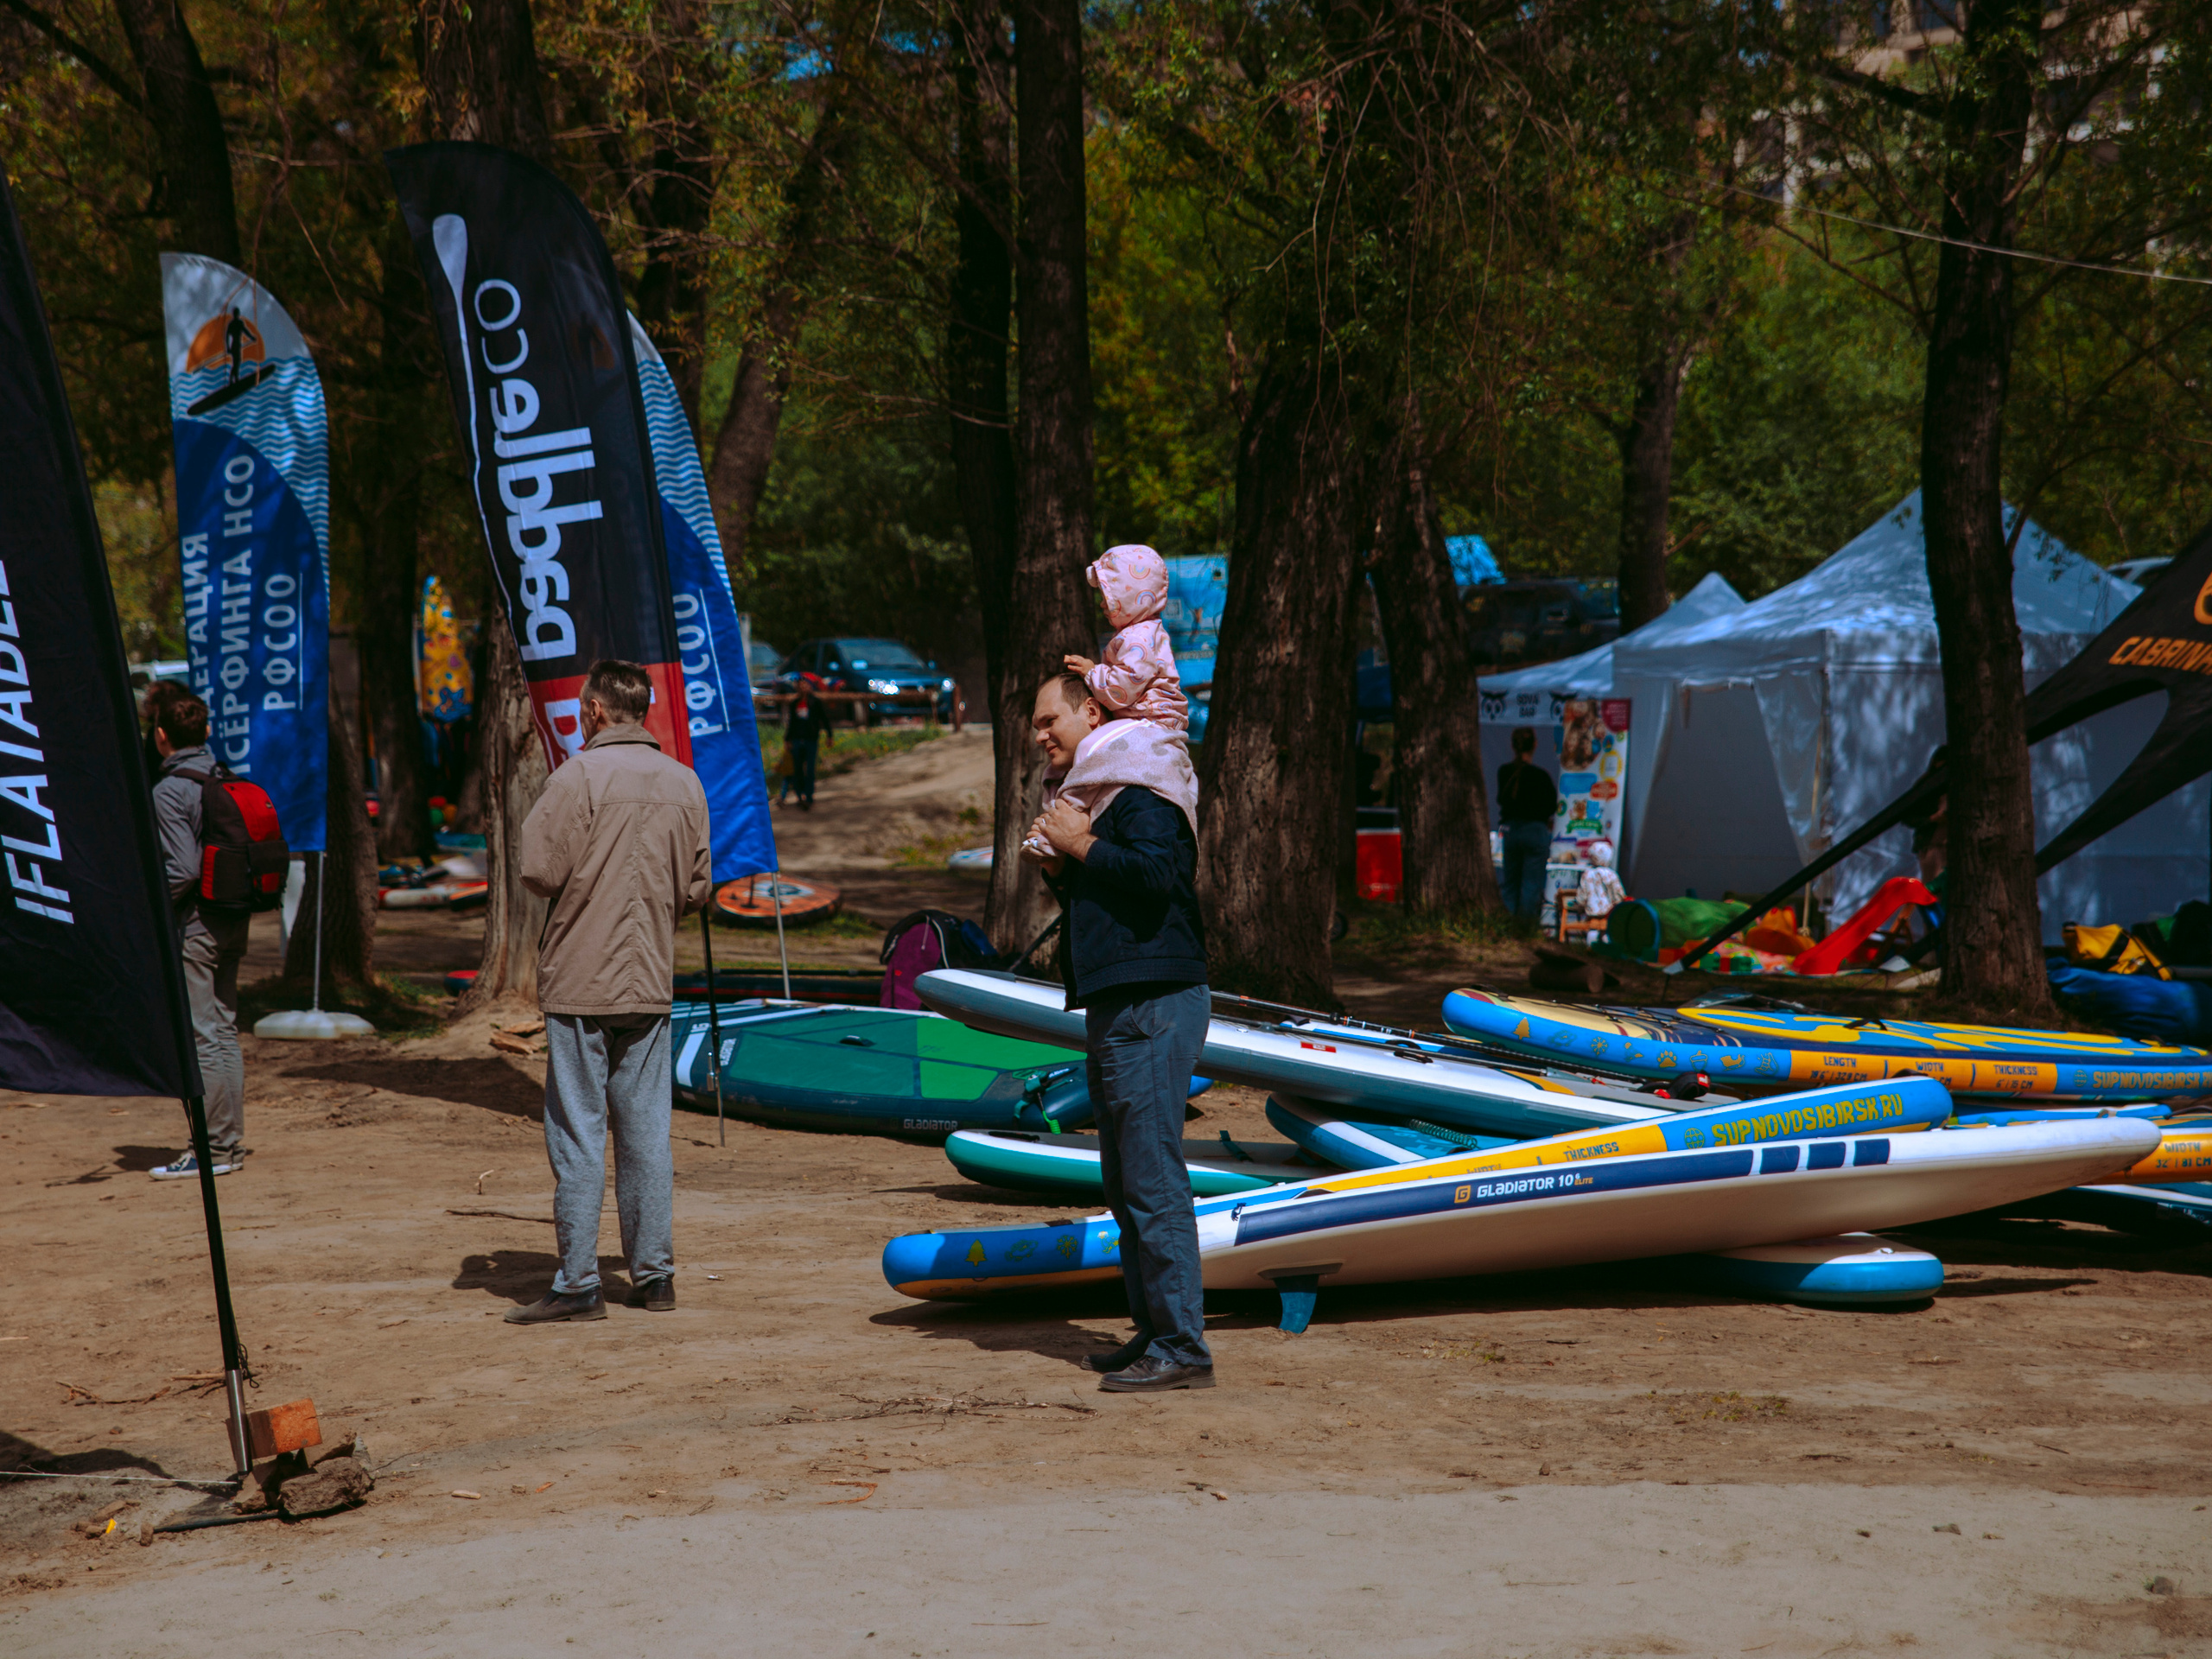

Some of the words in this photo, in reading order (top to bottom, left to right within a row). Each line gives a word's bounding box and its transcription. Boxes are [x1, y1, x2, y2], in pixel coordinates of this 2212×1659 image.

[224, 454, 255, 537] НСО
[264, 574, 296, 710] РФСОО
[672, 594, 723, 737] РФСОО
[1823, 1056, 1857, 1068] LENGTH
[1916, 1062, 1944, 1072] WIDTH
[1993, 1065, 2038, 1076] THICKNESS
[1711, 1093, 1903, 1147] SUPNOVOSIBIRSK.RU
[1563, 1141, 1620, 1162] THICKNESS
[2164, 1141, 2202, 1153] WIDTH
[2196, 1157, 2211, 1166] CM
[1477, 1176, 1555, 1198] GLADIATOR
[1574, 1177, 1593, 1185] ELITE
